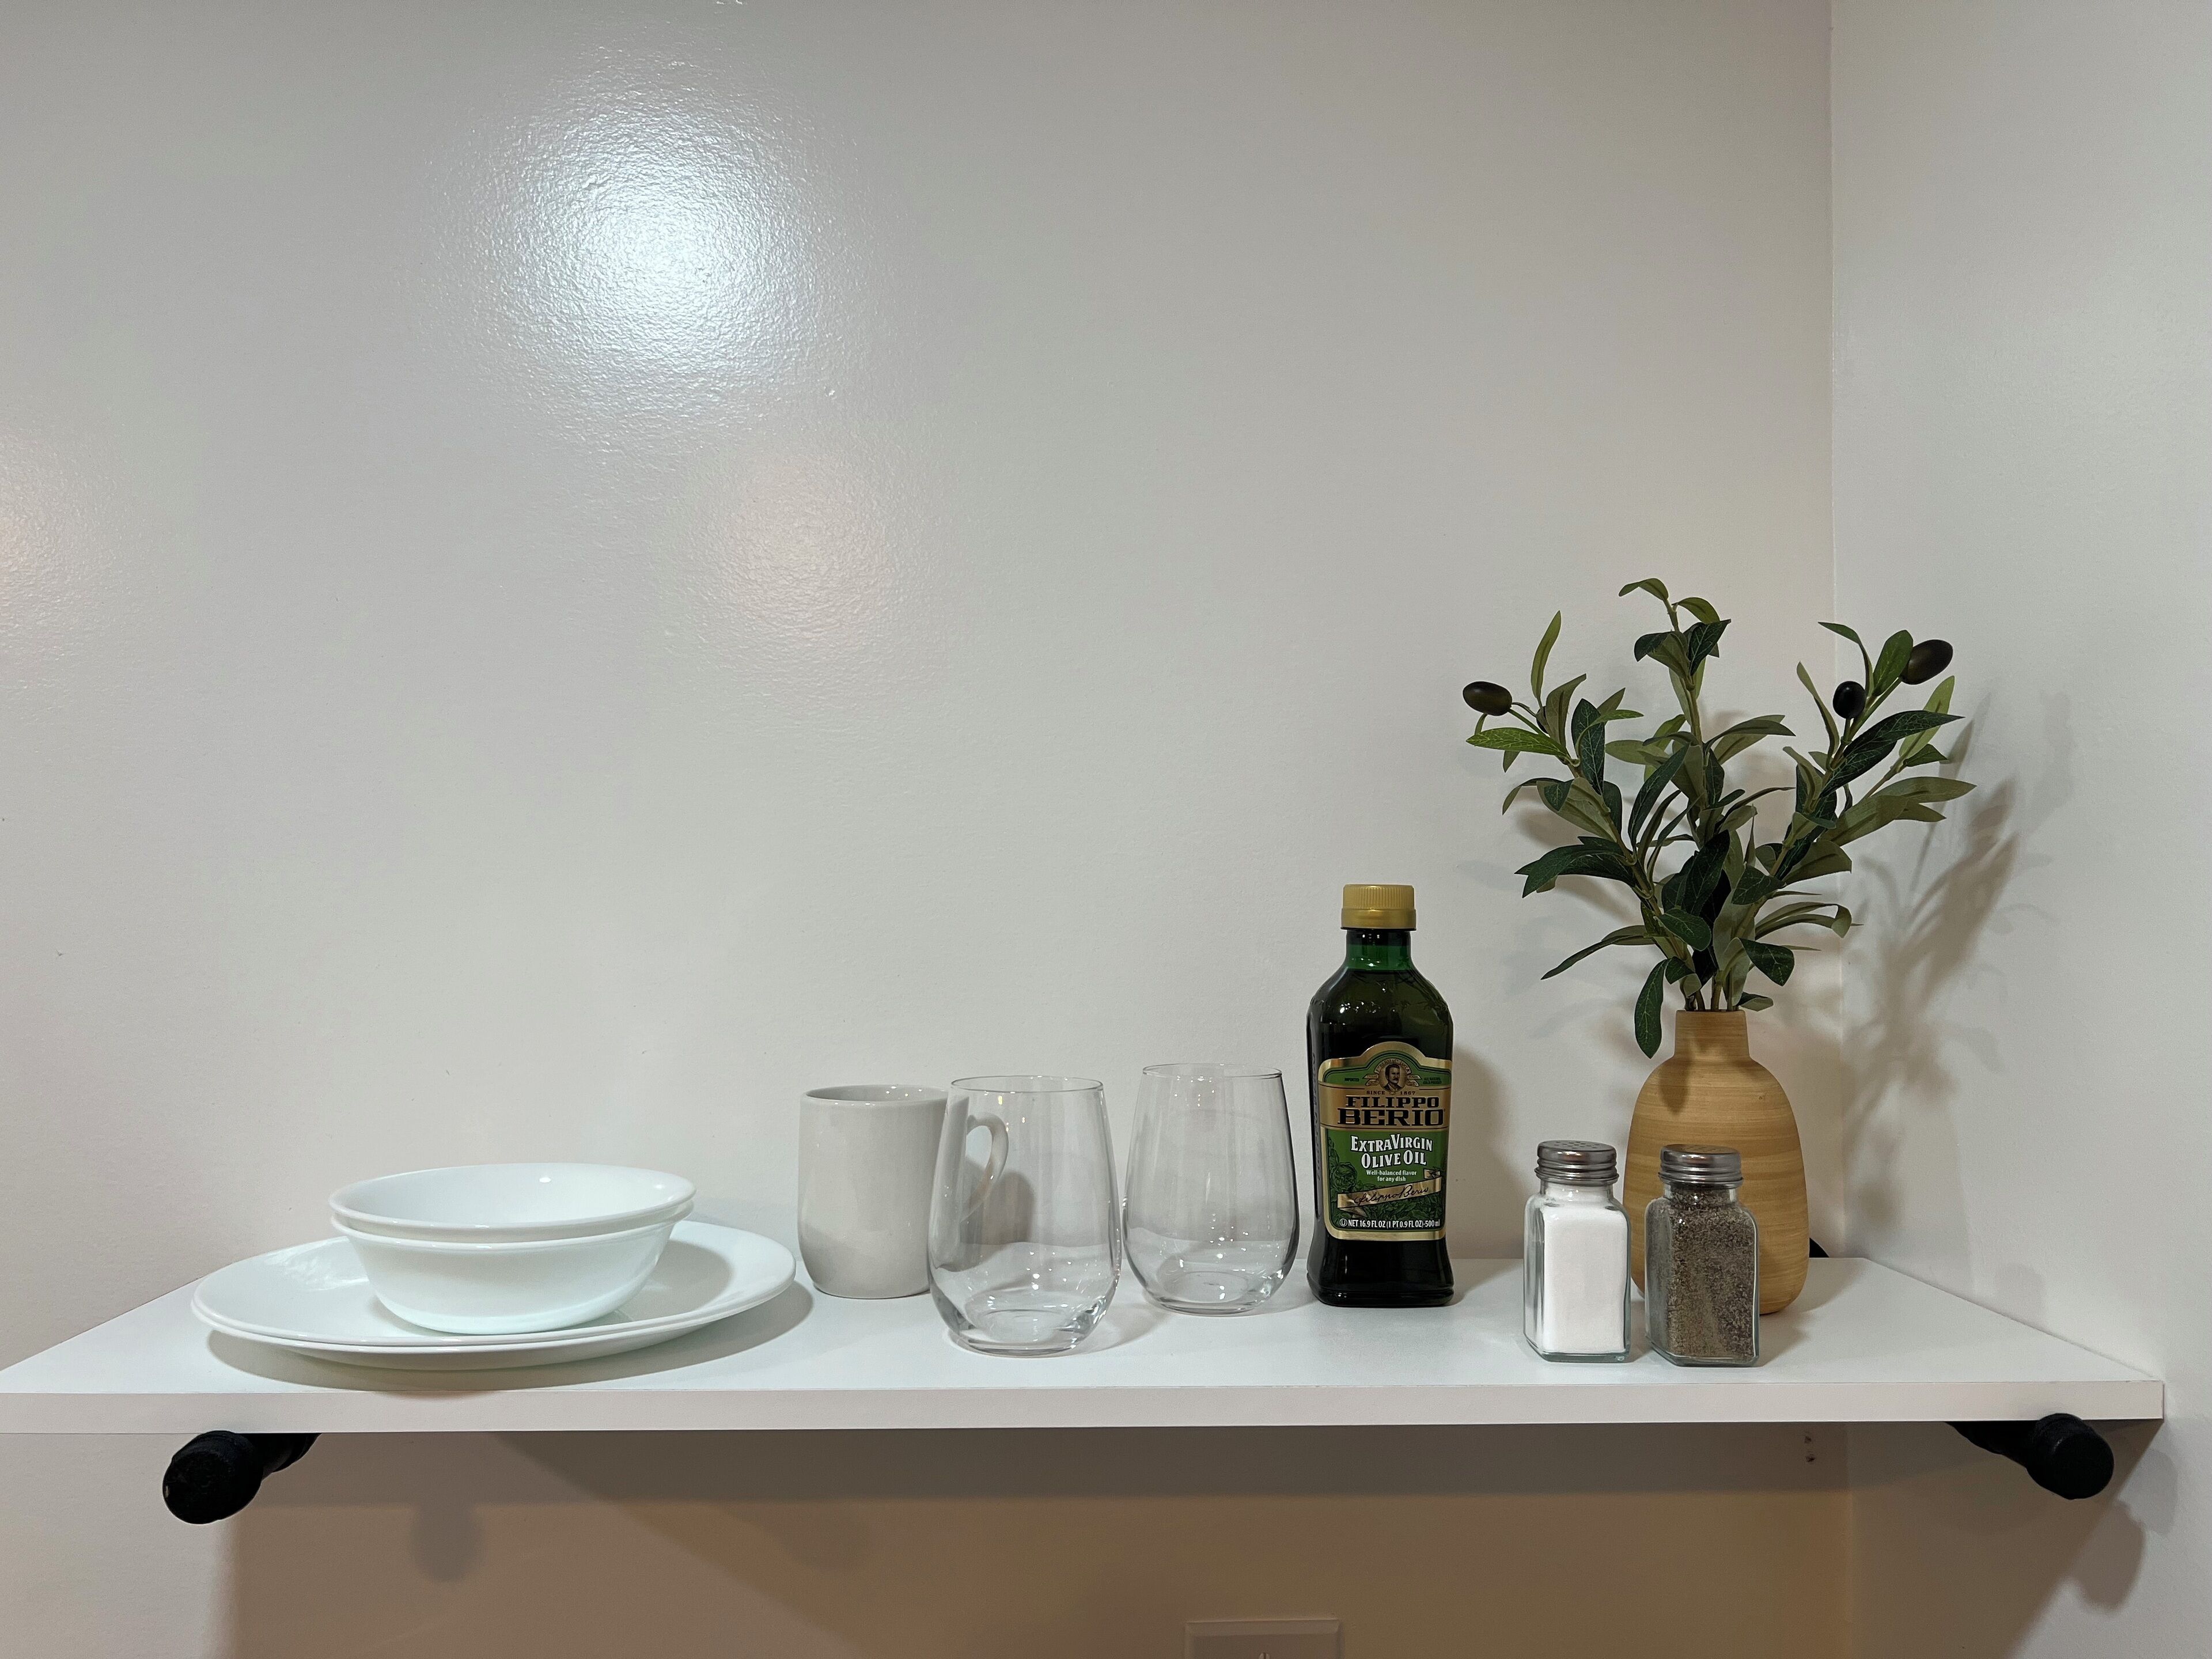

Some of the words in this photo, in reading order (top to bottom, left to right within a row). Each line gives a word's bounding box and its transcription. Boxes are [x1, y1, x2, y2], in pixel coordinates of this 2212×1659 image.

[1346, 1097, 1439, 1108] FILIPPO
[1338, 1108, 1444, 1126] BERIO
[1403, 1150, 1426, 1165] OIL
